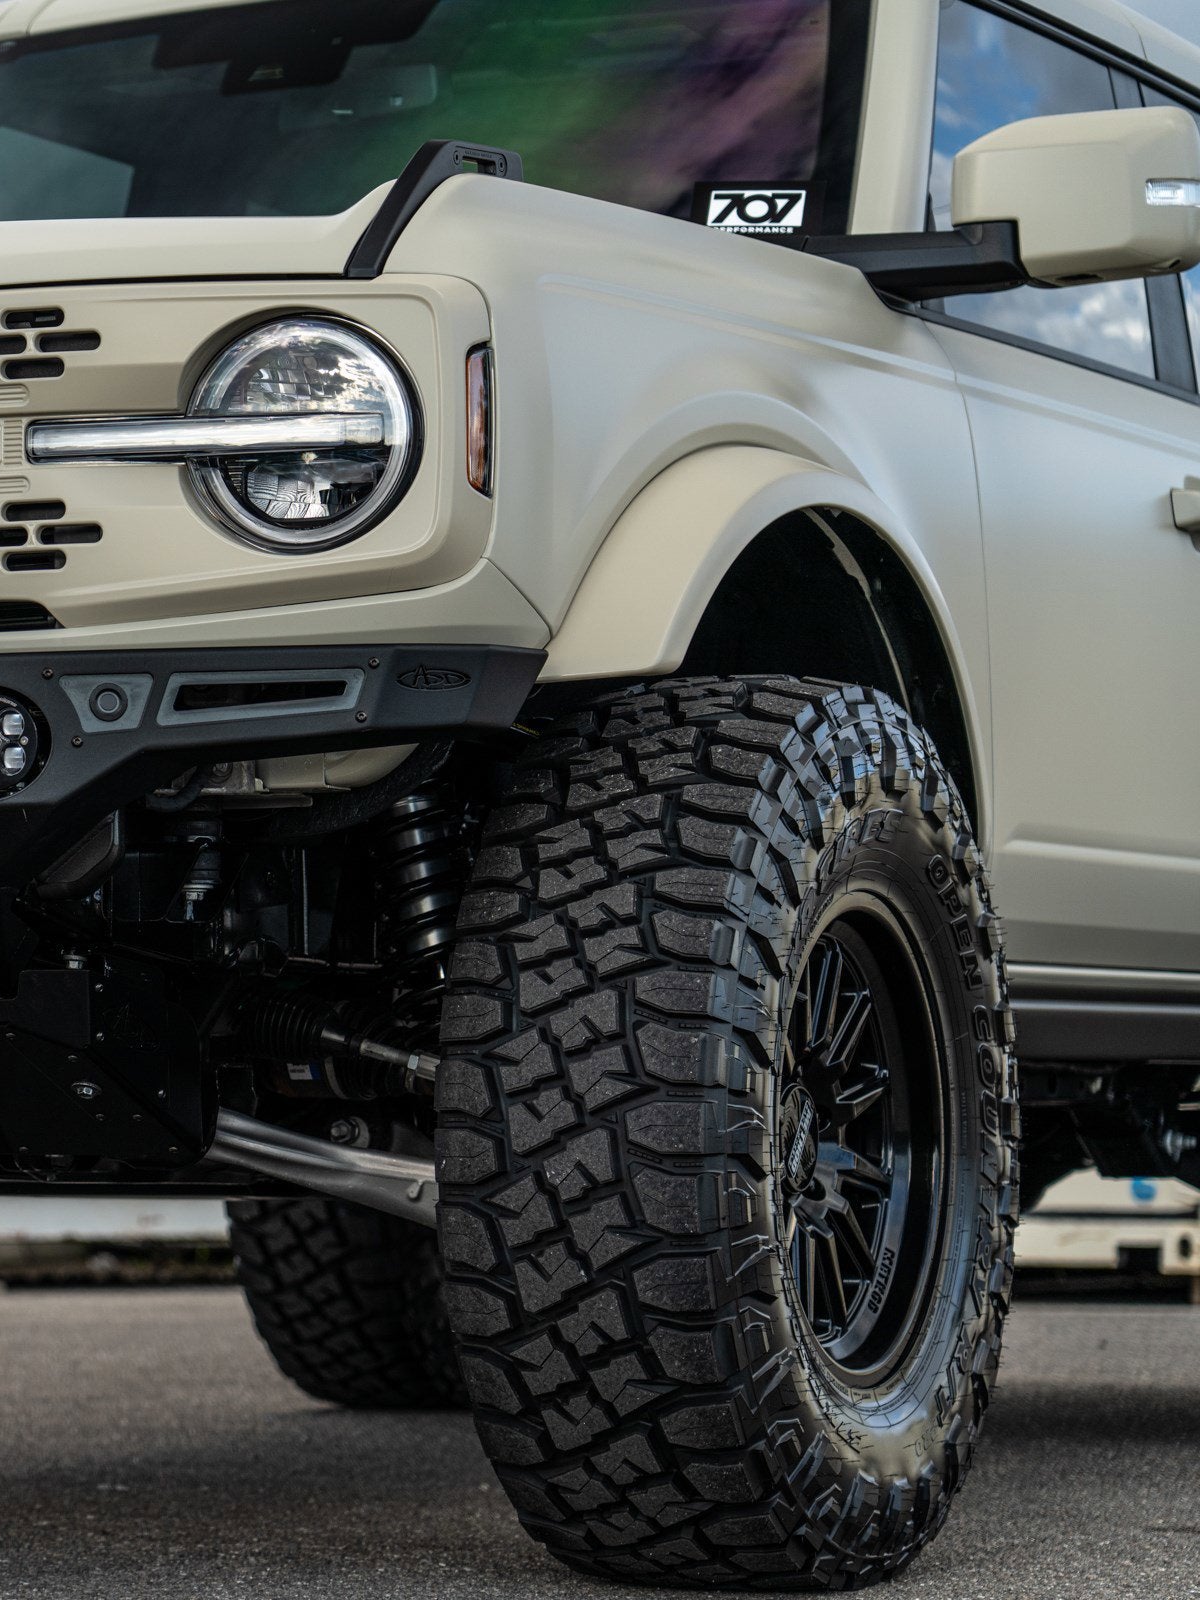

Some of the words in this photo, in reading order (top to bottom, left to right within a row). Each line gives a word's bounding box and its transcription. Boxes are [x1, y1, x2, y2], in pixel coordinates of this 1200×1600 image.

[711, 192, 804, 224] 707
[926, 853, 983, 991] OPEN
[968, 1004, 1001, 1318] COUNTRY
